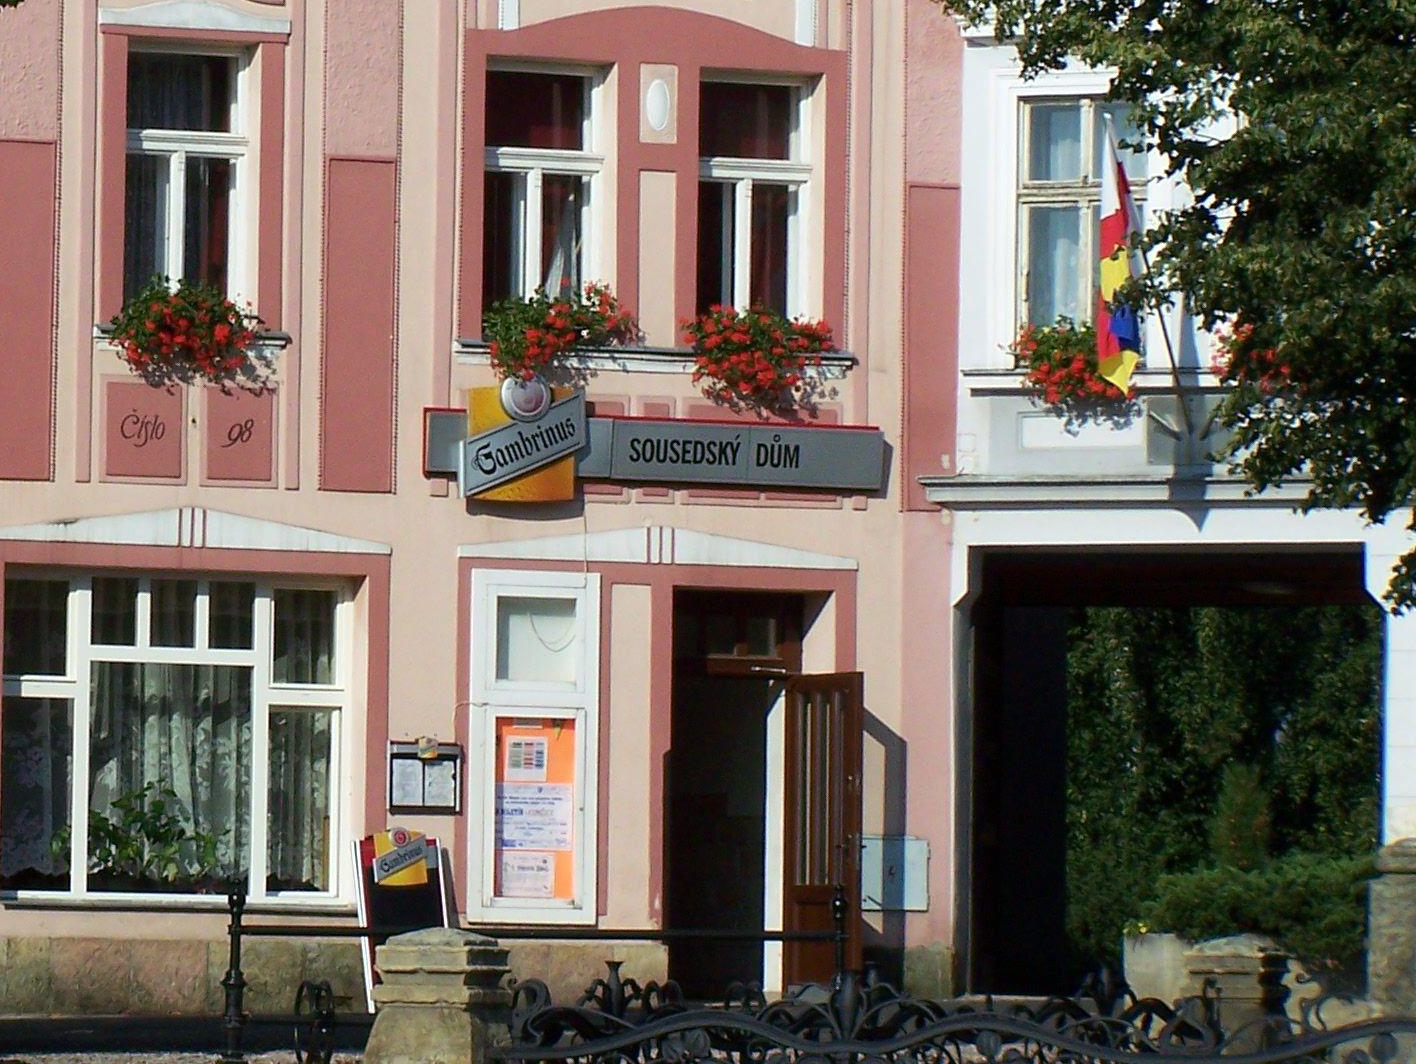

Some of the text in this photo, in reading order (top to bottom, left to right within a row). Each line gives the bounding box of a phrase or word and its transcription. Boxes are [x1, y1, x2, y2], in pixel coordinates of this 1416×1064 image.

[221, 419, 254, 448] 98
[472, 417, 577, 476] Gambrinus
[629, 434, 801, 469] SOUSEDSKÝ DŮM
